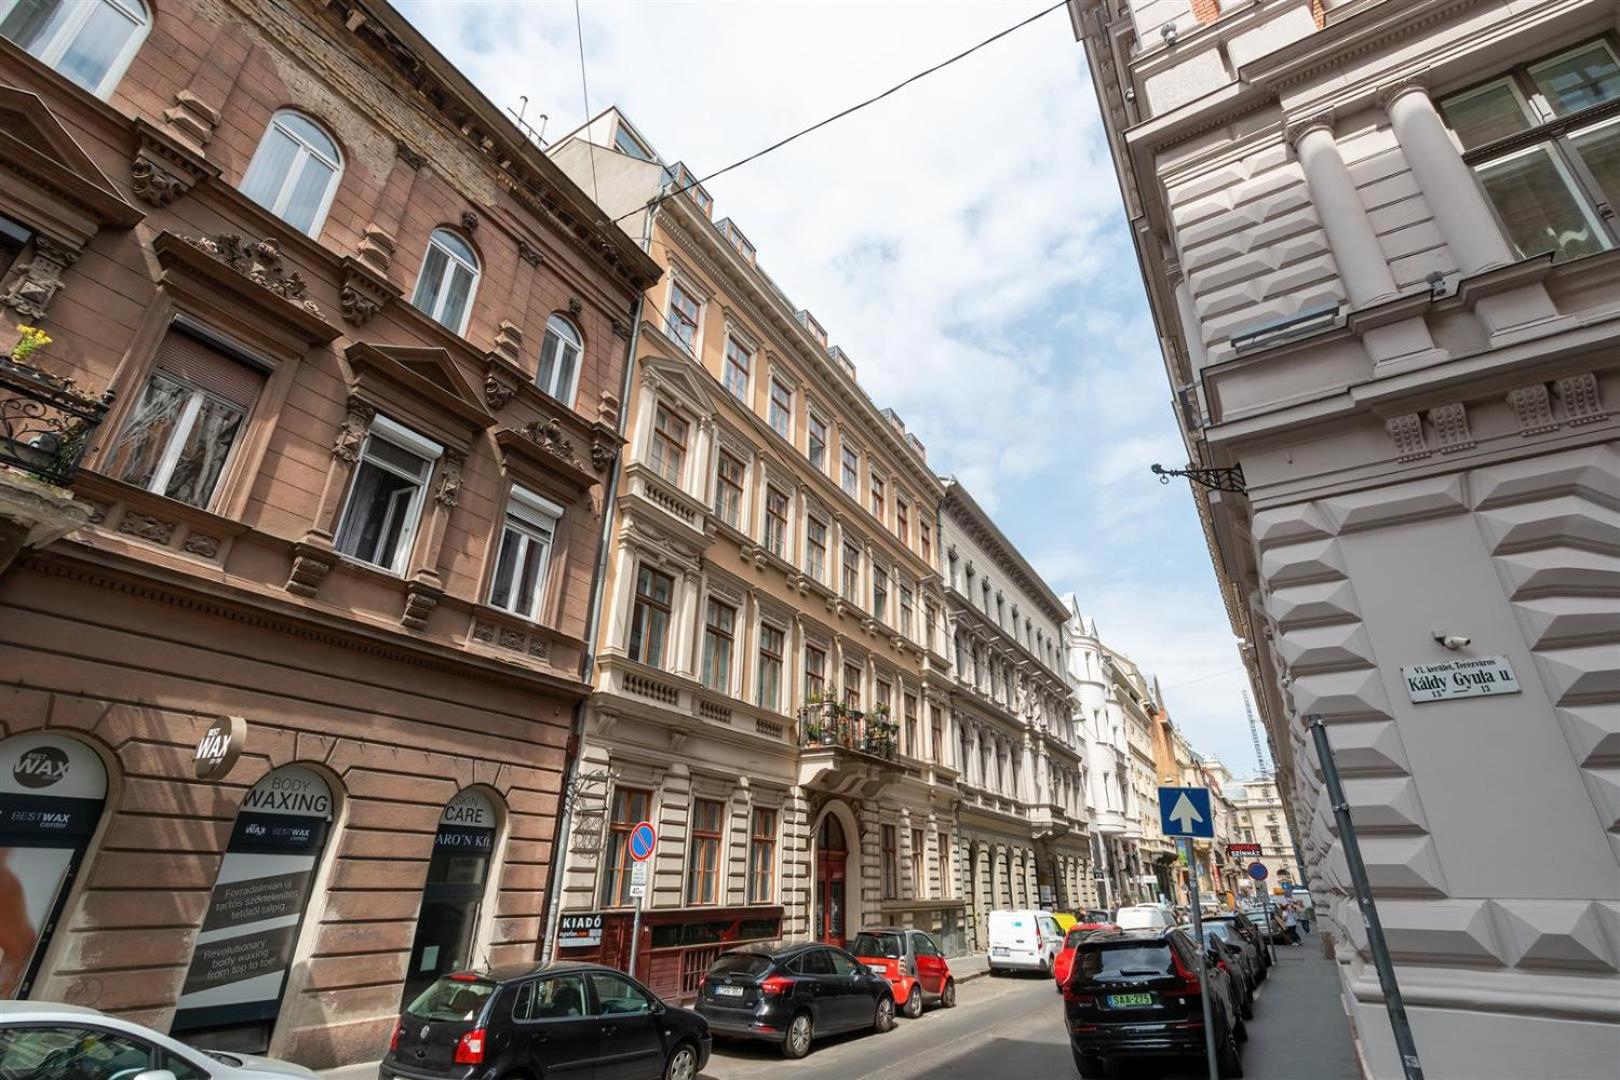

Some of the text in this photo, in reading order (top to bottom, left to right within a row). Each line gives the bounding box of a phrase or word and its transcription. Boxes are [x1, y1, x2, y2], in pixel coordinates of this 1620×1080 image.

[1408, 669, 1513, 692] Káldy Gyula u.
[197, 735, 232, 759] WAX
[14, 759, 71, 776] WAX
[271, 777, 311, 792] BODY
[243, 789, 328, 812] WAXING
[444, 806, 484, 823] CARE
[563, 915, 602, 928] KIADÓ
[212, 949, 269, 968] body waxing
[208, 968, 230, 979] from
[231, 965, 247, 974] top
